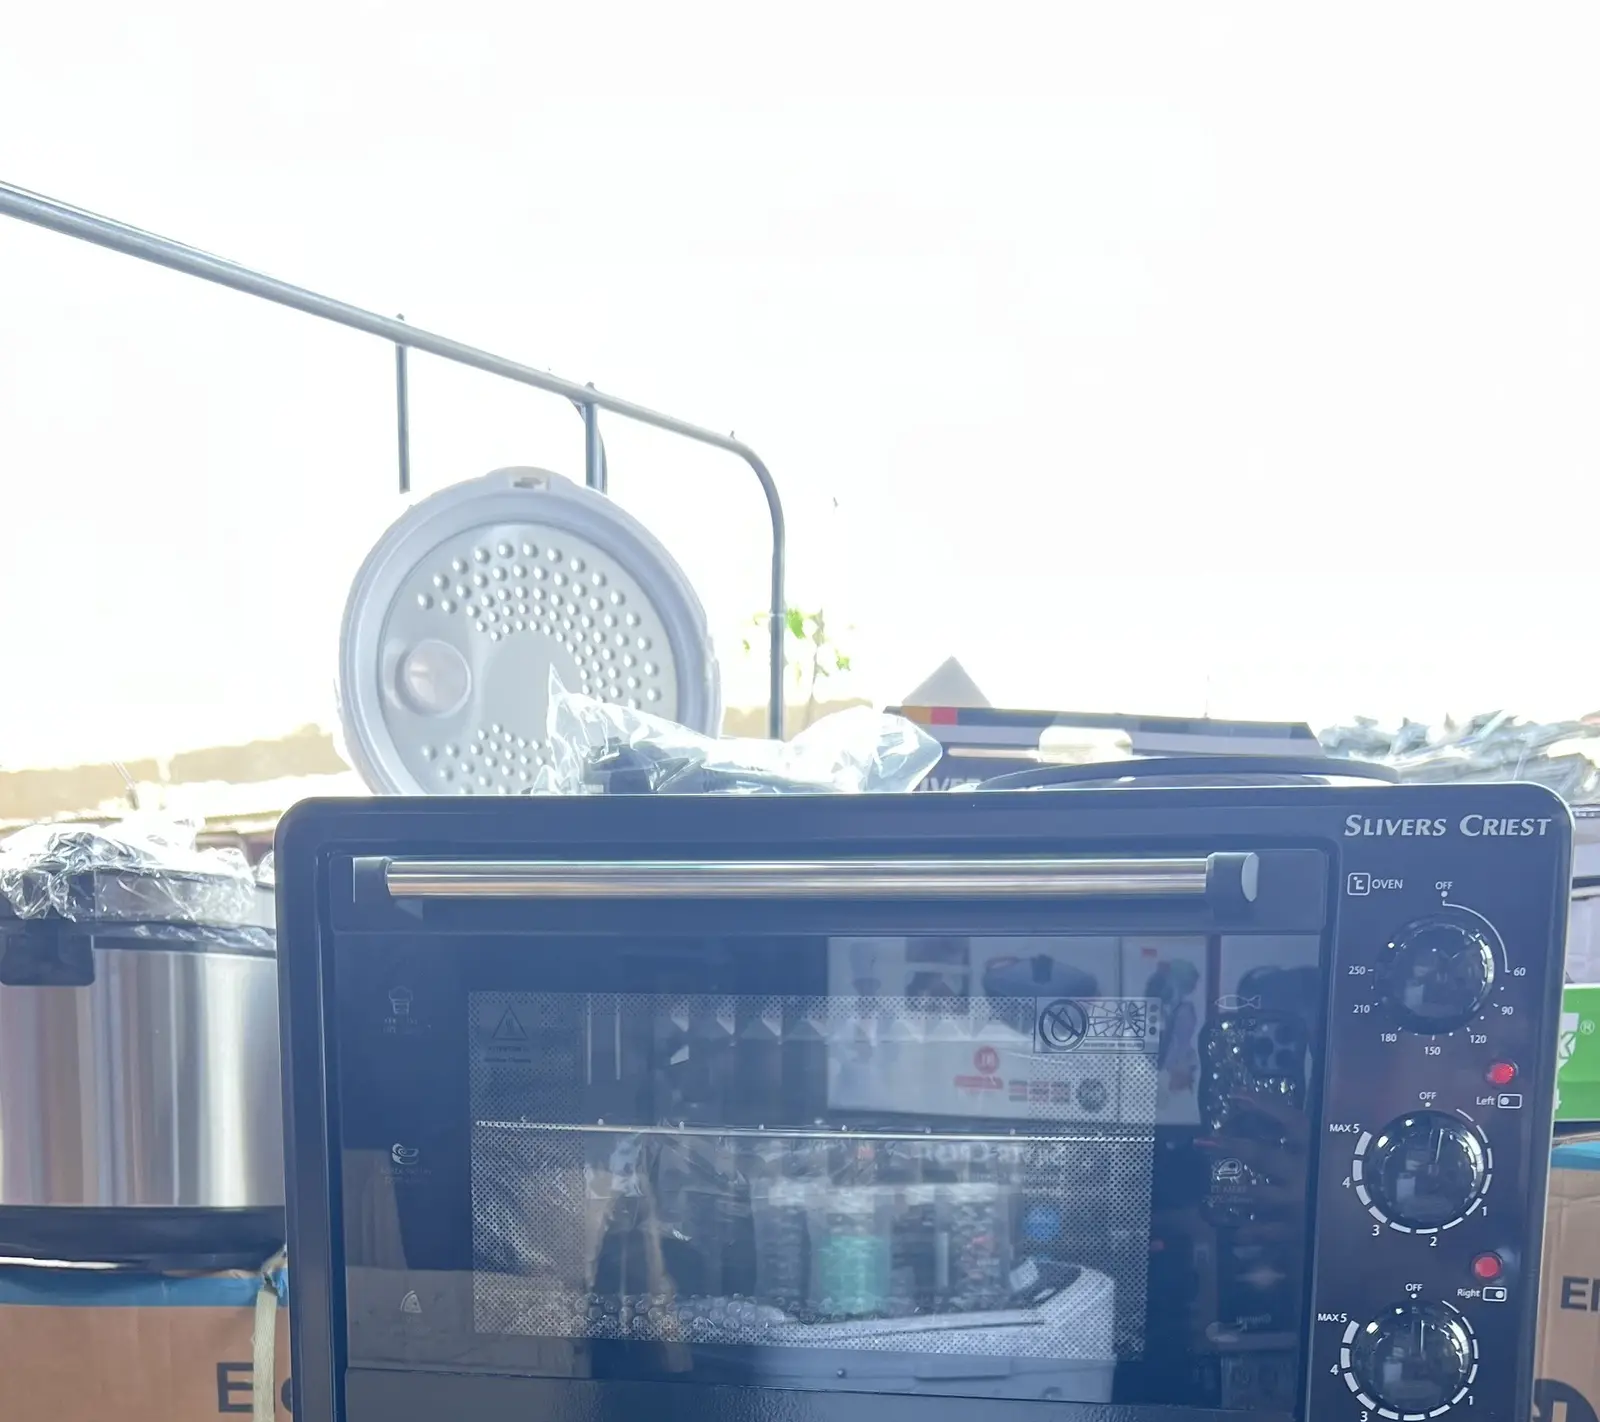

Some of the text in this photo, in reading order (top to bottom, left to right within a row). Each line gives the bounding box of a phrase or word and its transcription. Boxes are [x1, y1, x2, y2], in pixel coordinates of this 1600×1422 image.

[1344, 814, 1551, 837] SLIVERS CRIEST
[1372, 879, 1403, 889] OVEN
[1435, 881, 1453, 890] OFF
[1348, 966, 1366, 975] 250
[1513, 967, 1526, 977] 60
[1353, 1005, 1370, 1014] 210
[1501, 1006, 1514, 1016] 90
[1380, 1033, 1397, 1043] 180
[1470, 1034, 1487, 1044] 120
[1424, 1046, 1441, 1056] 150
[1419, 1091, 1437, 1100] OFF
[1476, 1096, 1495, 1106] Left
[1329, 1123, 1360, 1134] MAX 5
[1341, 1176, 1351, 1188] 4
[1372, 1225, 1380, 1236] 3
[1429, 1236, 1437, 1247] 2
[1405, 1283, 1423, 1292] OFF
[1457, 1288, 1480, 1299] Right
[1317, 1312, 1347, 1323] MAX 5
[1330, 1364, 1339, 1375] 4
[1360, 1411, 1368, 1422] 3
